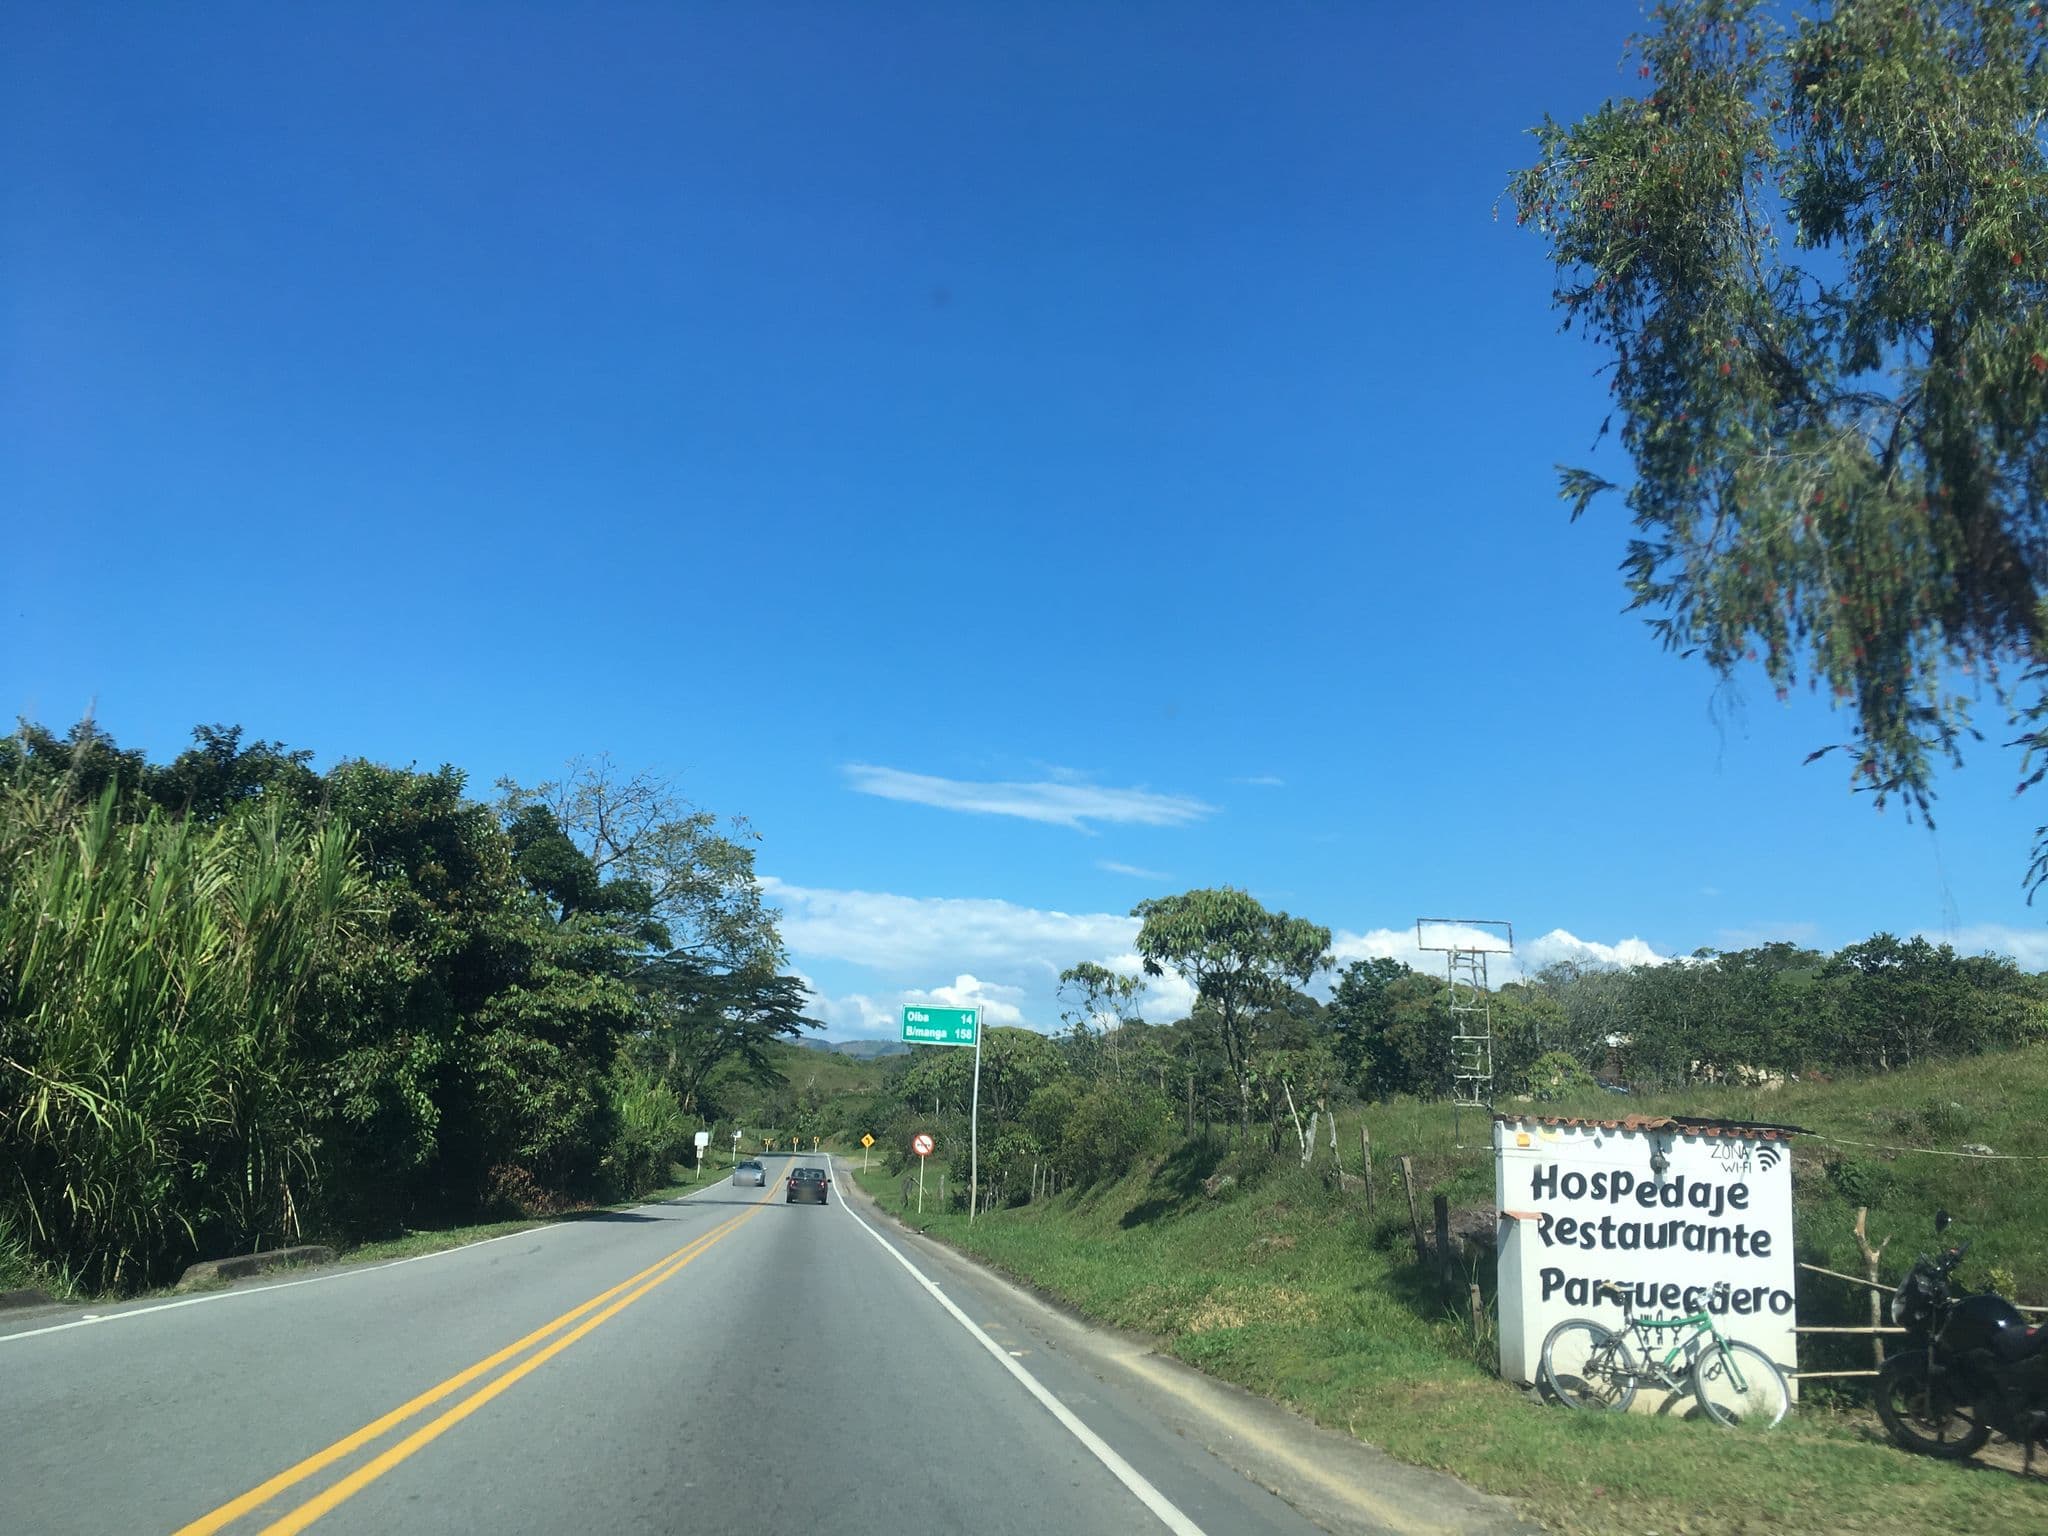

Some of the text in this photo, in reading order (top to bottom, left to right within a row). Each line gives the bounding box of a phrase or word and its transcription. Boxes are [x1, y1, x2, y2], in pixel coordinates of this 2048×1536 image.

[960, 1013, 973, 1024] 14
[906, 1025, 972, 1040] B/manga 158
[1711, 1144, 1749, 1160] ZONA
[1721, 1161, 1752, 1174] WI-FI
[1531, 1163, 1749, 1217] Hospedaje
[1537, 1211, 1772, 1258] Restaurante
